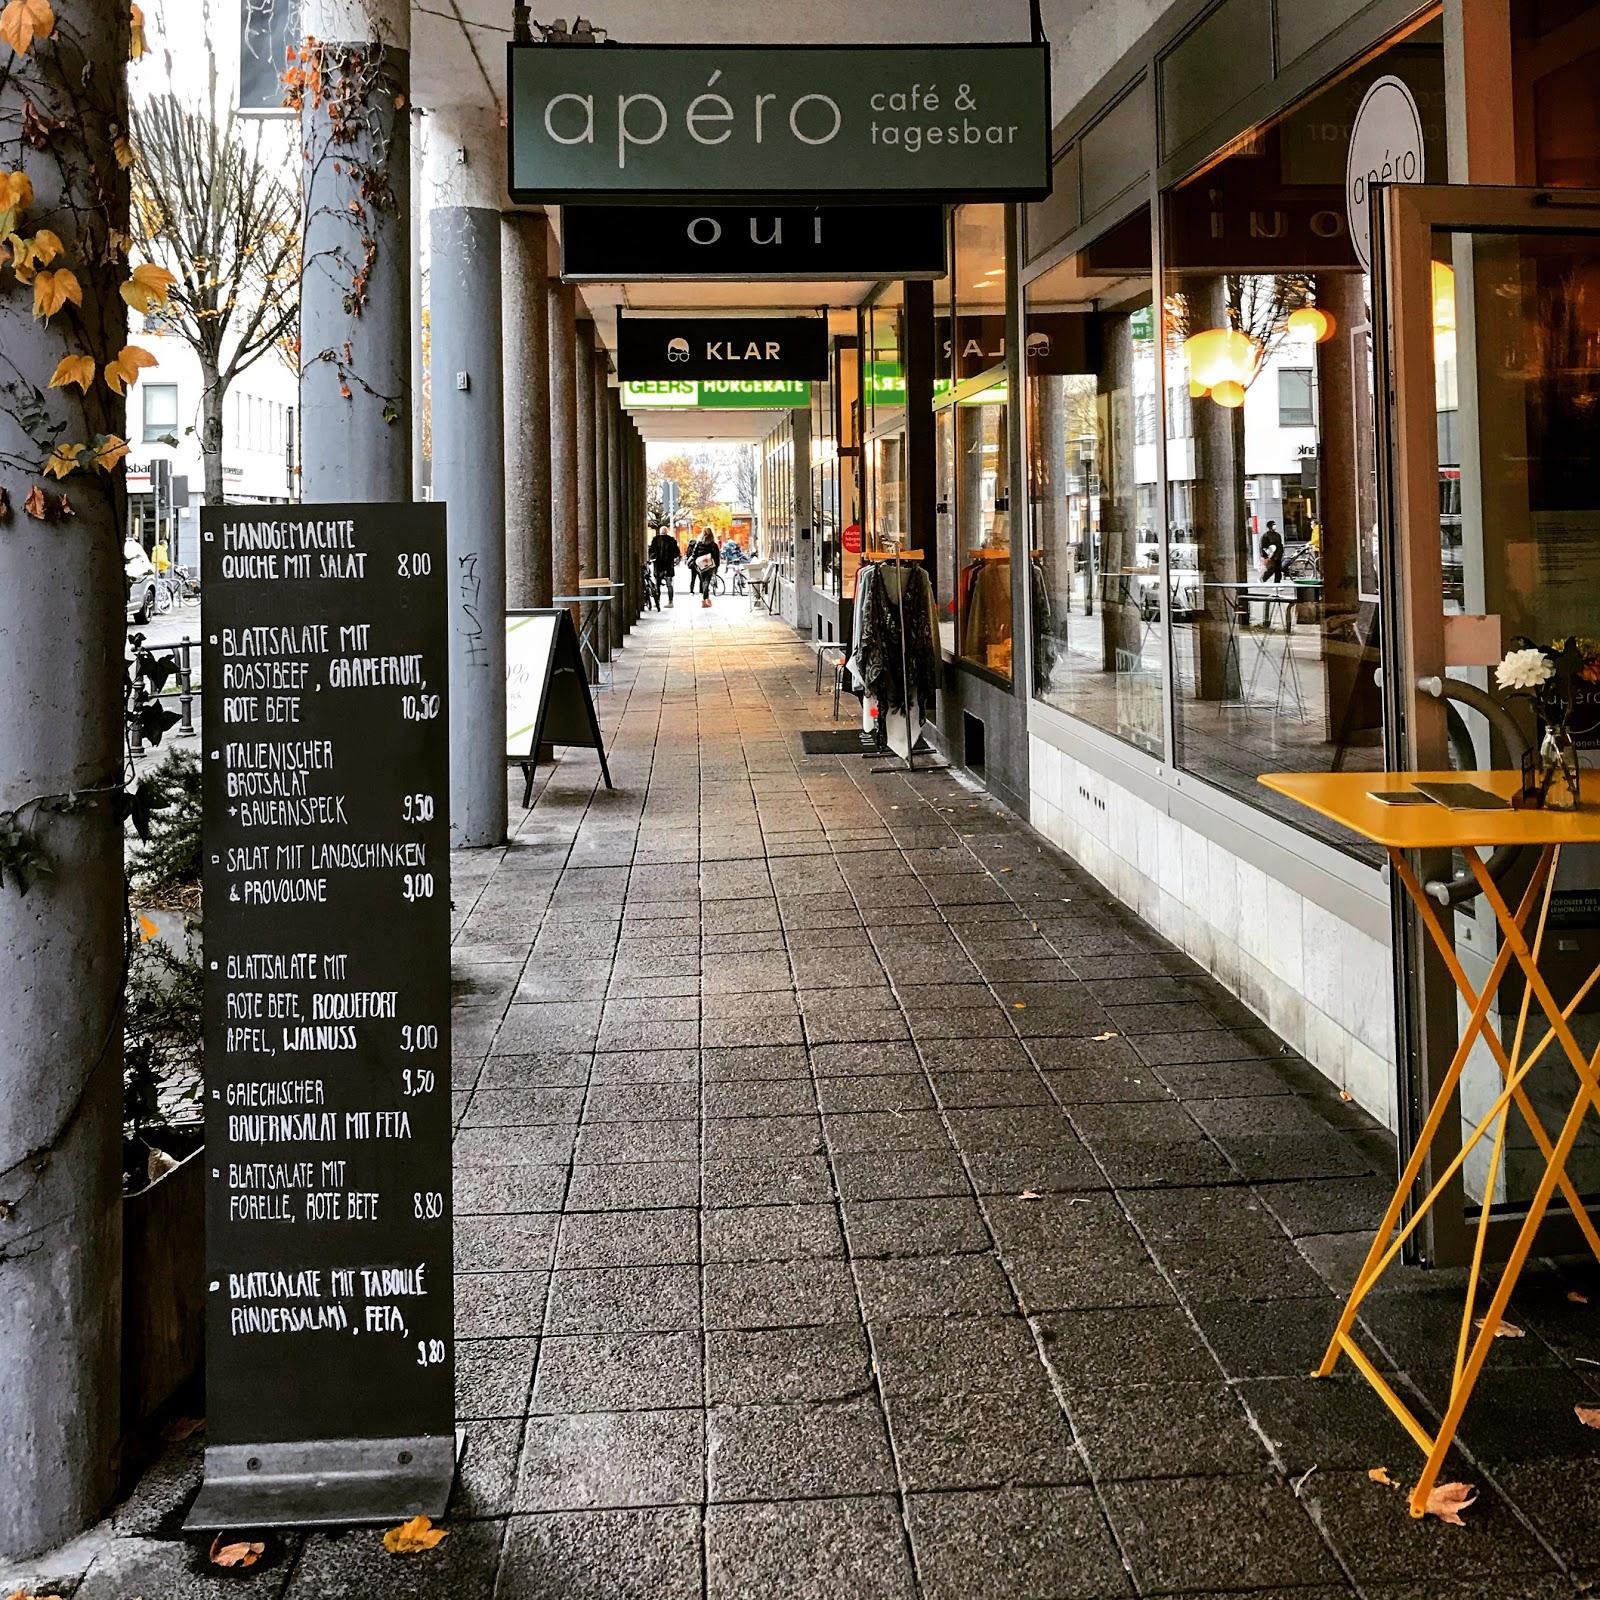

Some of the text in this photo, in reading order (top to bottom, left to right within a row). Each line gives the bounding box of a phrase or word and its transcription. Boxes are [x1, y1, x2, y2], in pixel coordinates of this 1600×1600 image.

[871, 84, 976, 110] café &
[545, 70, 840, 168] apéro
[871, 119, 1017, 152] tagesbar
[686, 207, 823, 245] oui
[707, 342, 780, 360] KLAR
[629, 380, 694, 394] GEERS
[224, 520, 355, 551] HANDGEMACHTE
[222, 553, 431, 579] QUICHE MIT SALAT 8,00
[223, 624, 370, 656] BLATTSALATE MIT
[330, 655, 426, 690] GRAPEFRUIT,
[224, 695, 440, 723] ROTE BETE 10,50
[226, 740, 332, 770] ITALIENISCHER
[228, 770, 309, 797] BROTSALAT
[403, 794, 433, 823] 9,50
[227, 843, 425, 872] SALAT MIT LANDSCHINKEN
[230, 873, 433, 905] & PROVOLONE 9,00
[227, 953, 347, 980] BLATTSALATE MIT
[227, 992, 398, 1023] ROTE BETE, ROQUEFORT
[227, 1025, 437, 1056] APFEL, WALNUSS 9,00
[227, 1069, 434, 1106] GRIECHISCHER 9,50
[229, 1111, 411, 1146] BAUERNSALAT MIT FETA
[229, 1161, 346, 1189] BLATTSALATE MIT
[230, 1194, 295, 1223] FORELLE,
[307, 1192, 341, 1220] ROTE
[348, 1192, 379, 1220] BETE
[230, 1270, 321, 1299] BLATTSALATE
[360, 1263, 427, 1297] TABOULÉ
[365, 1306, 408, 1338] FETA,
[417, 1339, 445, 1367] 9,80
